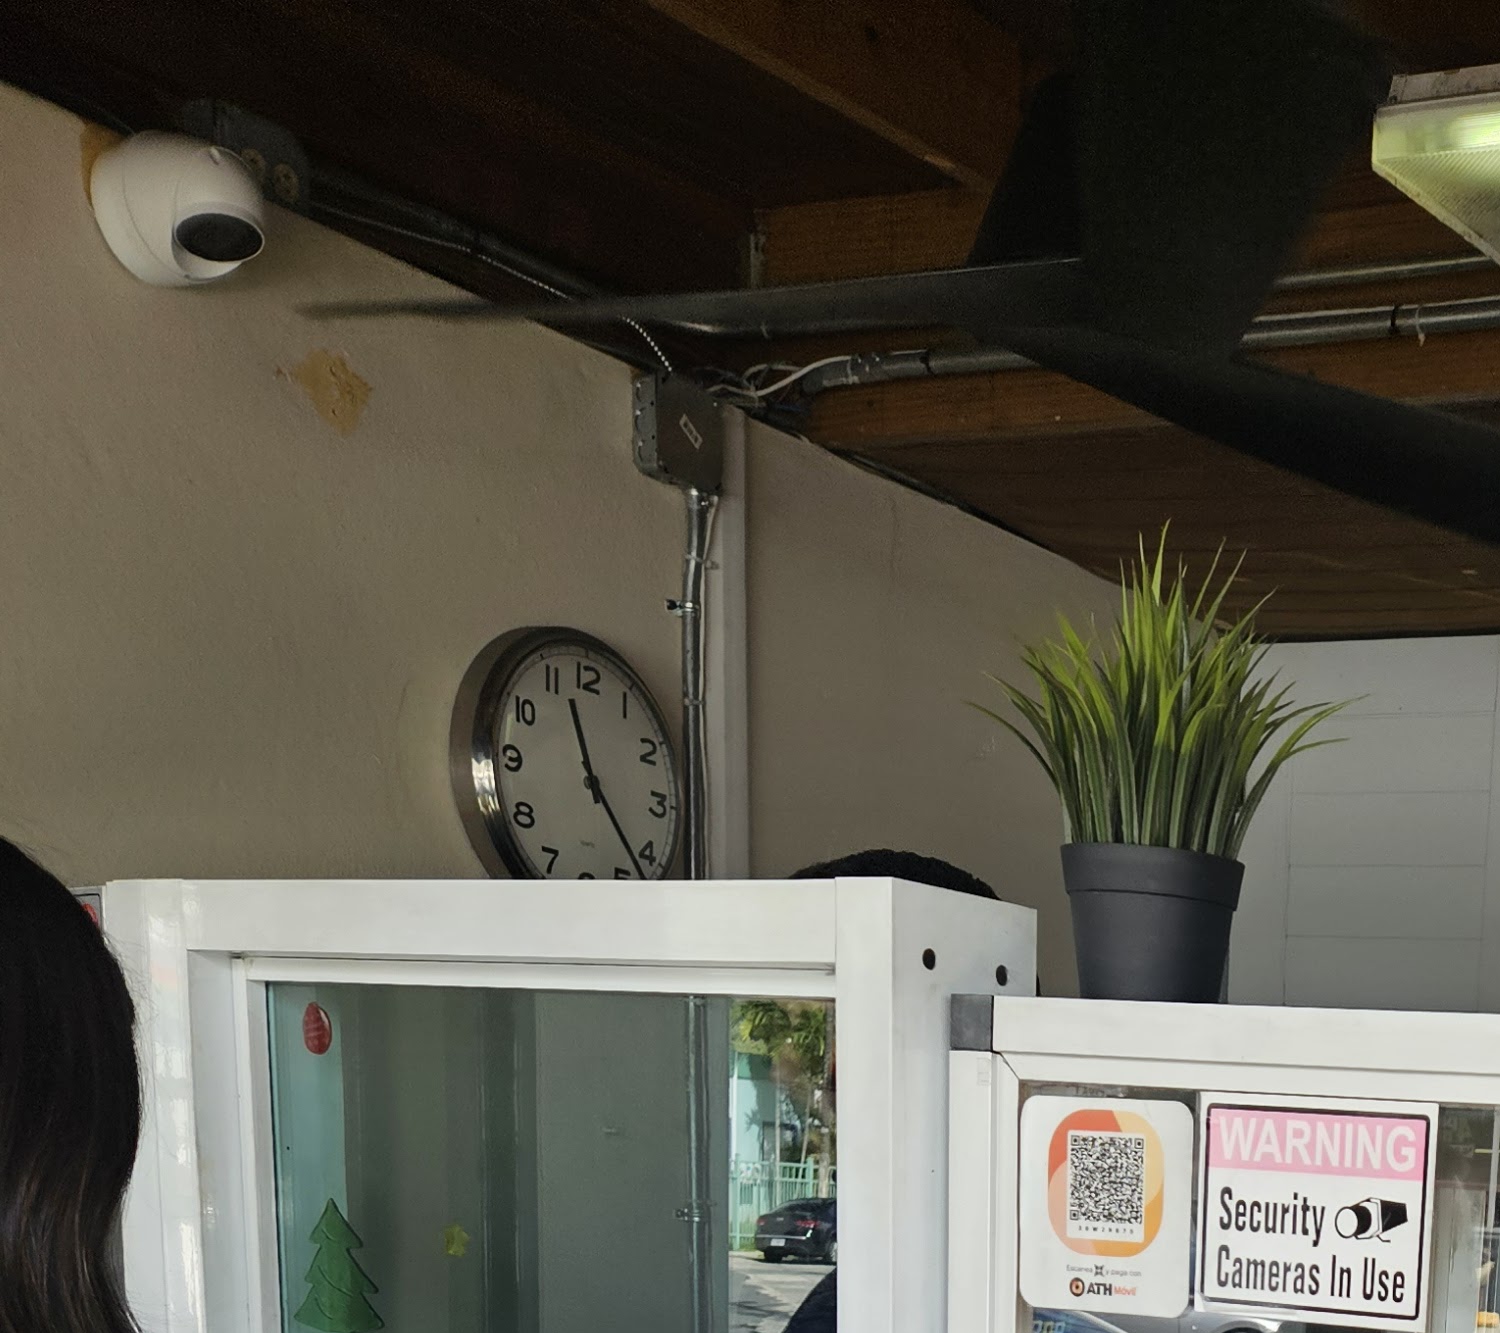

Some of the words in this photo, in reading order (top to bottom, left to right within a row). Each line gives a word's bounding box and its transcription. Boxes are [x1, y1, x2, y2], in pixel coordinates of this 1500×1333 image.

[545, 664, 559, 695] 11
[576, 661, 601, 696] 12
[515, 694, 536, 726] 10
[622, 691, 627, 720] 1
[502, 744, 523, 772] 9
[639, 738, 657, 767] 2
[513, 801, 536, 829] 8
[648, 790, 667, 819] 3
[541, 846, 559, 874] 7
[638, 840, 657, 867] 4
[1219, 1115, 1417, 1172] WARNING
[1219, 1186, 1326, 1248] Security
[1217, 1244, 1320, 1296] Cameras
[1330, 1254, 1352, 1299] In
[1362, 1257, 1406, 1303] Use
[1086, 1281, 1113, 1297] ATH
